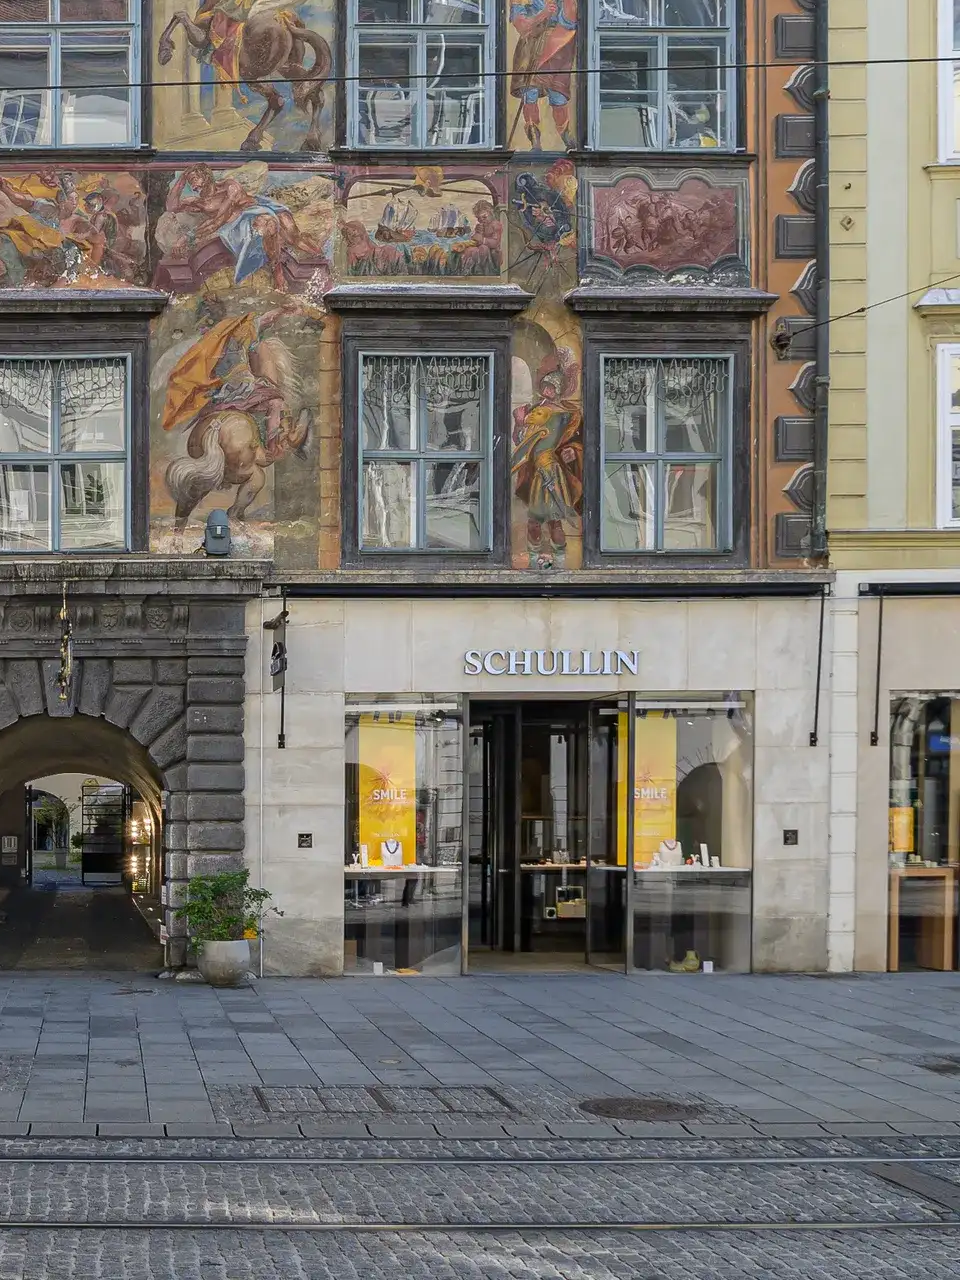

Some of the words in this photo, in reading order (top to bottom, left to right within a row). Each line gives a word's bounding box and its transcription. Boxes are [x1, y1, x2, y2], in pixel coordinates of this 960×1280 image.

[464, 650, 640, 676] SCHULLIN
[372, 789, 407, 801] SMILE
[633, 787, 668, 799] SMILE
